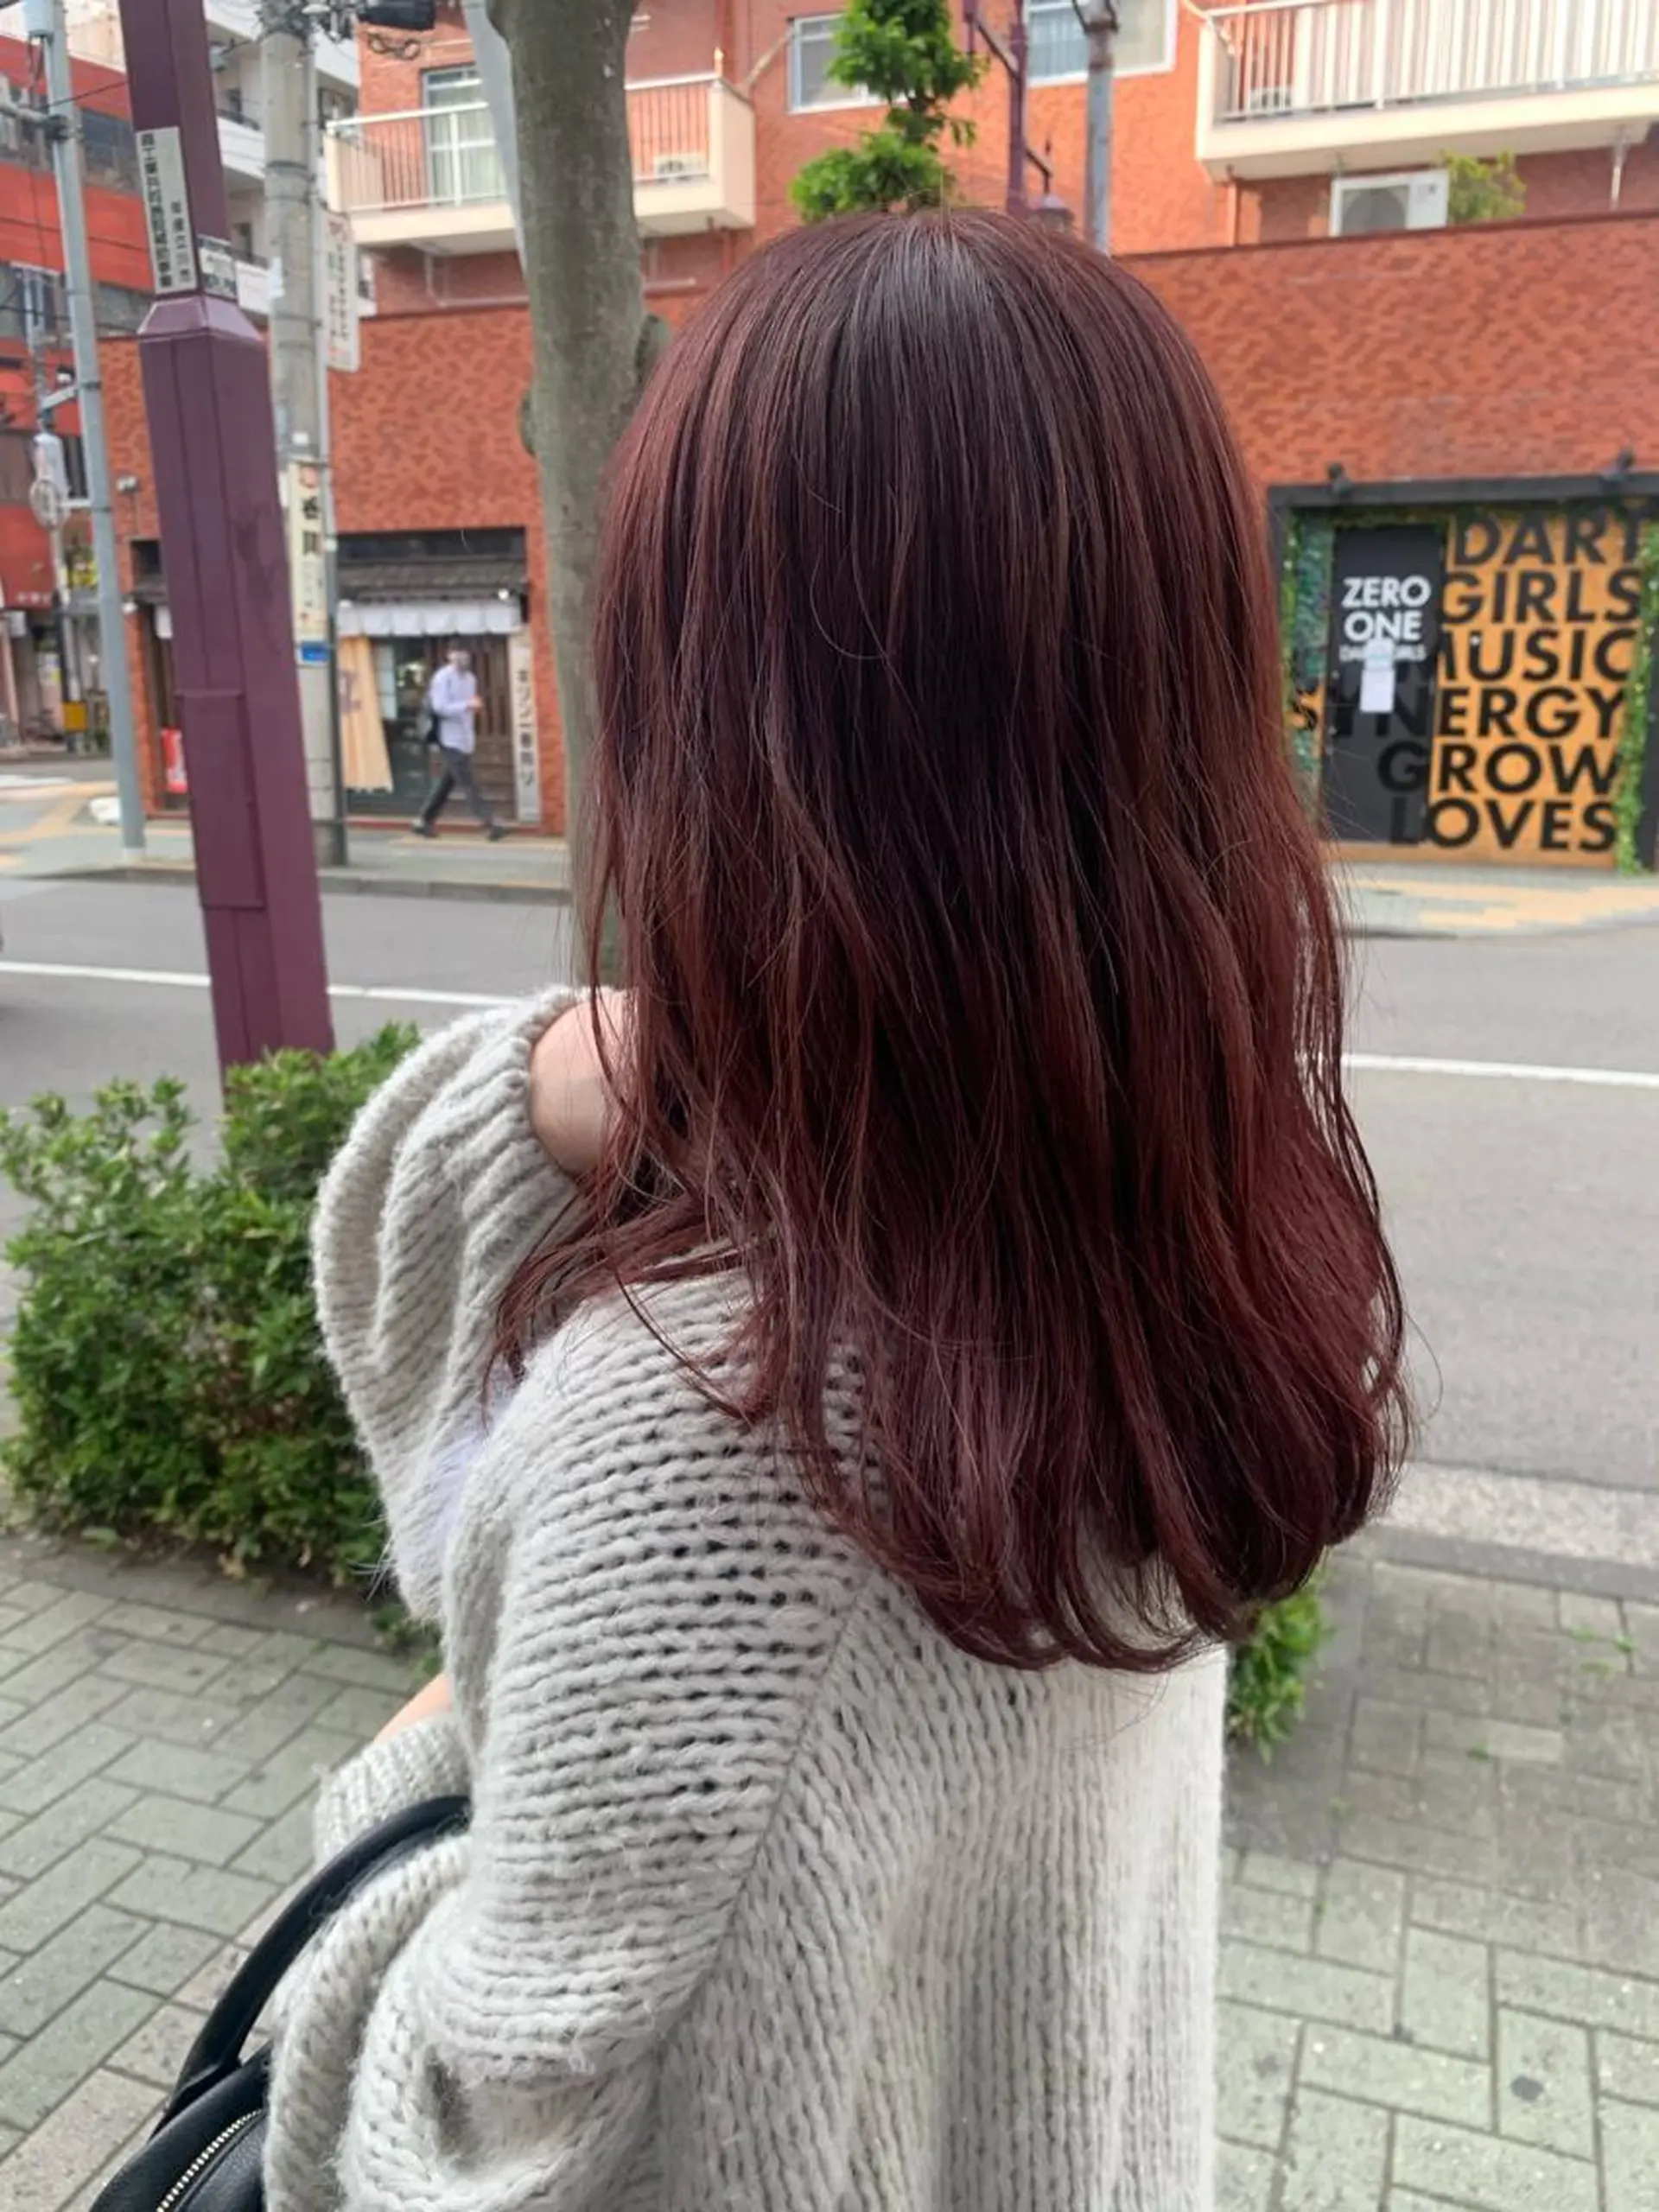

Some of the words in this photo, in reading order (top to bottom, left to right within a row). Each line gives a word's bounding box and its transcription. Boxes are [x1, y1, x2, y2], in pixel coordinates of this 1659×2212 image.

[1342, 575, 1431, 607] ZERO
[1437, 569, 1640, 624] GIRLS
[1344, 610, 1422, 641] ONE
[1378, 742, 1621, 794] GROW
